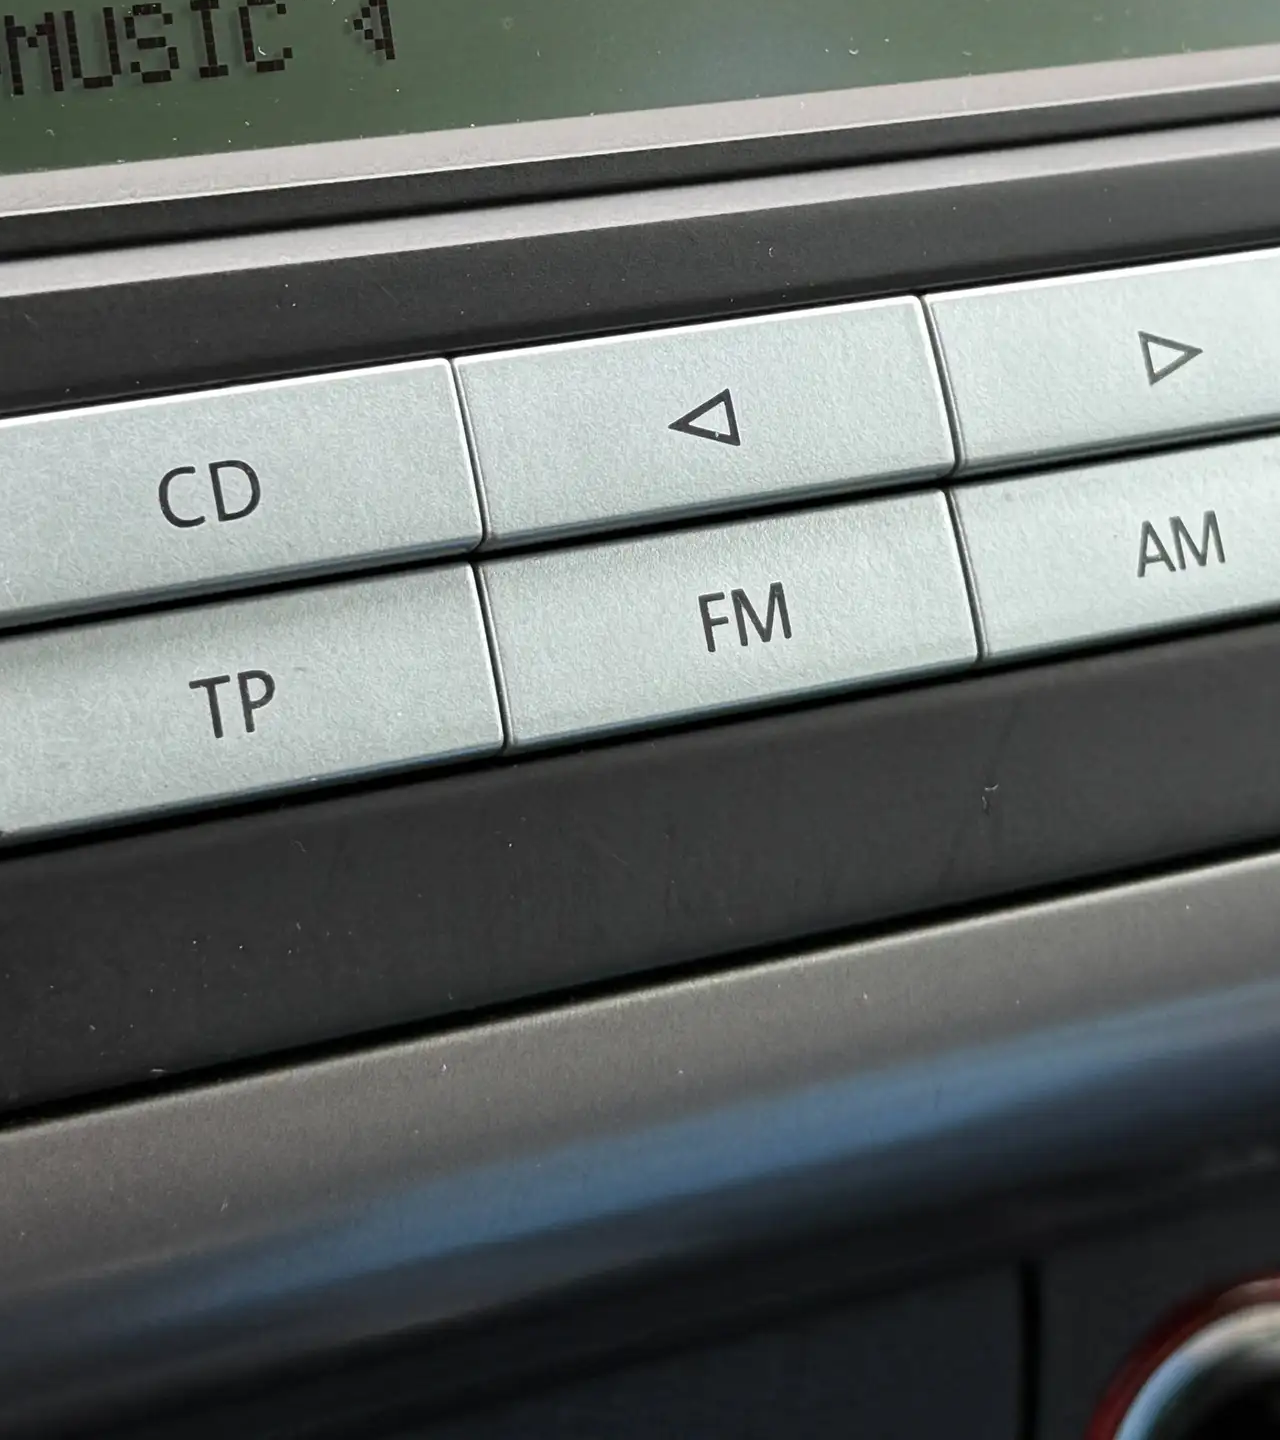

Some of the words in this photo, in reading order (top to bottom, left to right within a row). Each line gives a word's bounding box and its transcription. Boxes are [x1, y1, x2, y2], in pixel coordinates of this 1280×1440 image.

[156, 457, 262, 531] CD
[1135, 511, 1228, 579] AM
[697, 581, 793, 654] FM
[188, 667, 278, 741] TP
